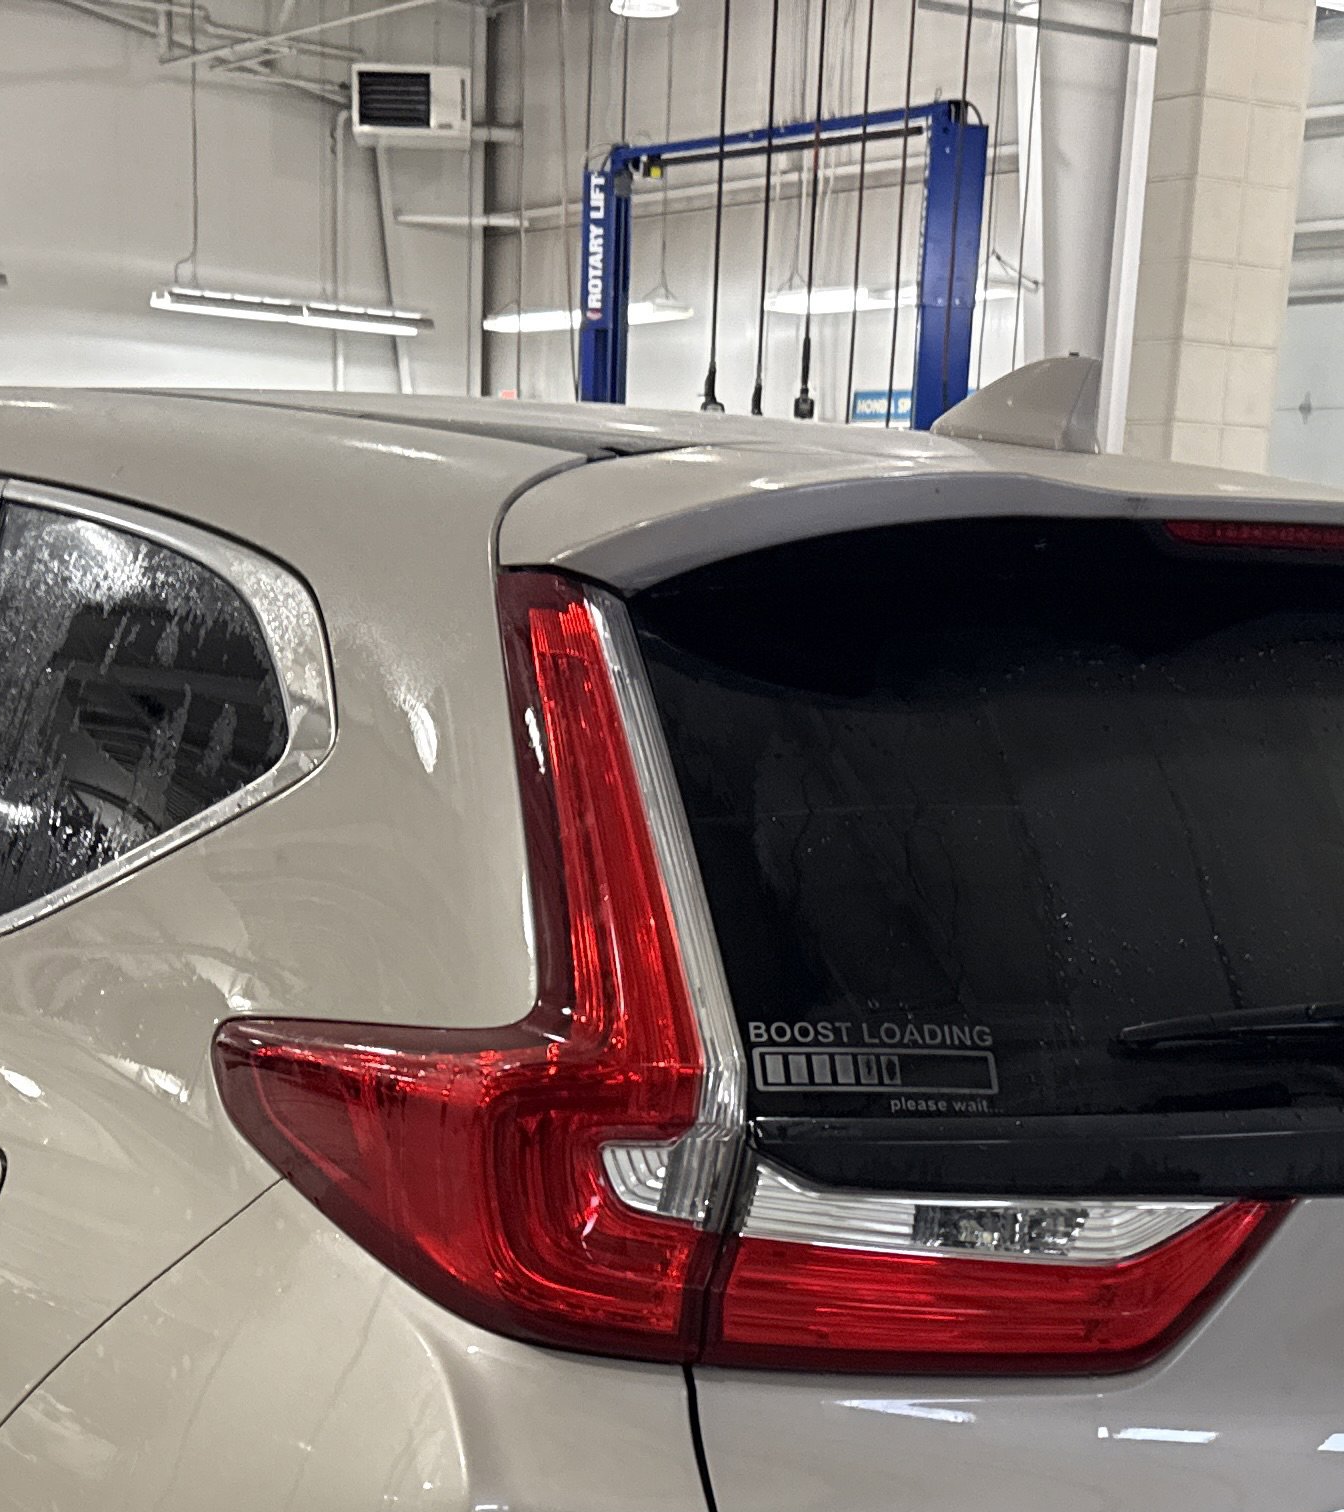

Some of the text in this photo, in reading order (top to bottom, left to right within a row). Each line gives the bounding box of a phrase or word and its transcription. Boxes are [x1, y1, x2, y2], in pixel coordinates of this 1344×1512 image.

[587, 172, 606, 309] ROTARY LIFT
[748, 1021, 993, 1046] BOOST LOADING
[891, 1098, 947, 1115] please
